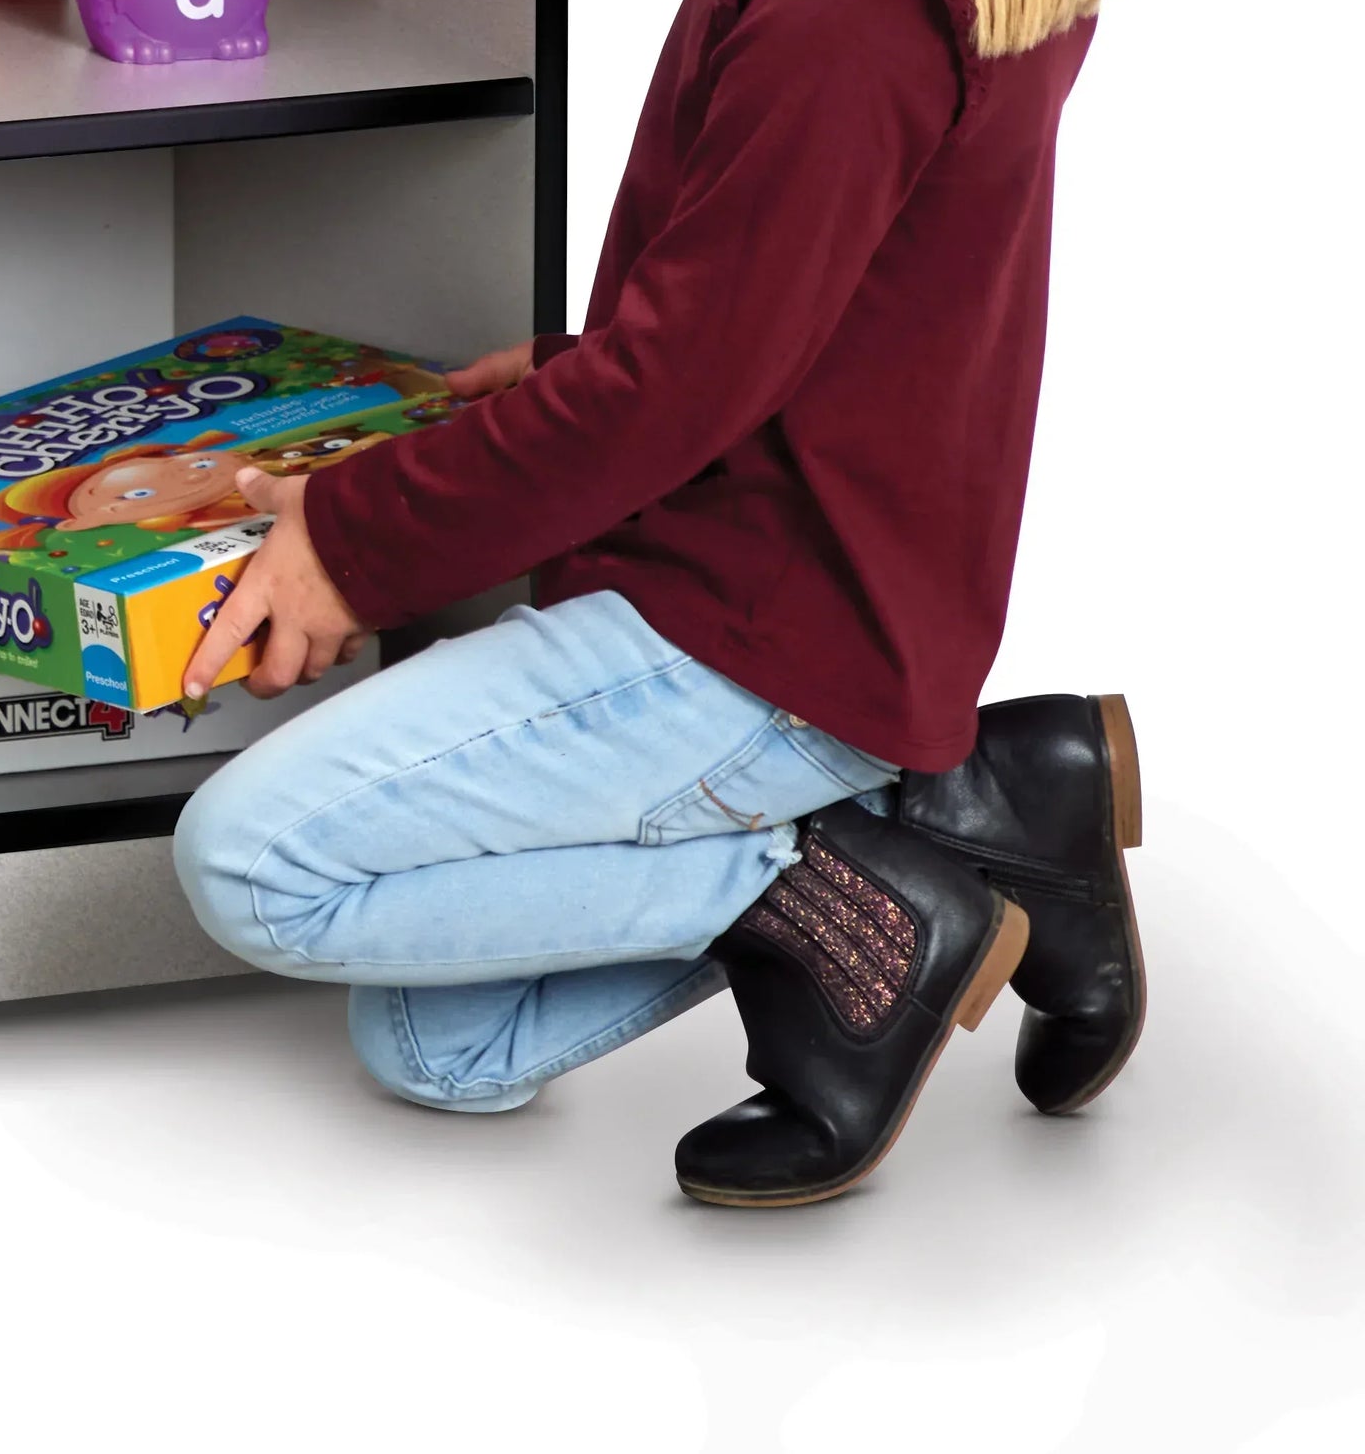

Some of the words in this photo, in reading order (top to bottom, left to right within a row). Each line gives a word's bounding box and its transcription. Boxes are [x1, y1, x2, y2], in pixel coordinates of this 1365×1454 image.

[110, 558, 180, 584] Preschool
[85, 671, 127, 691] Preschool
[89, 699, 126, 733] 4
